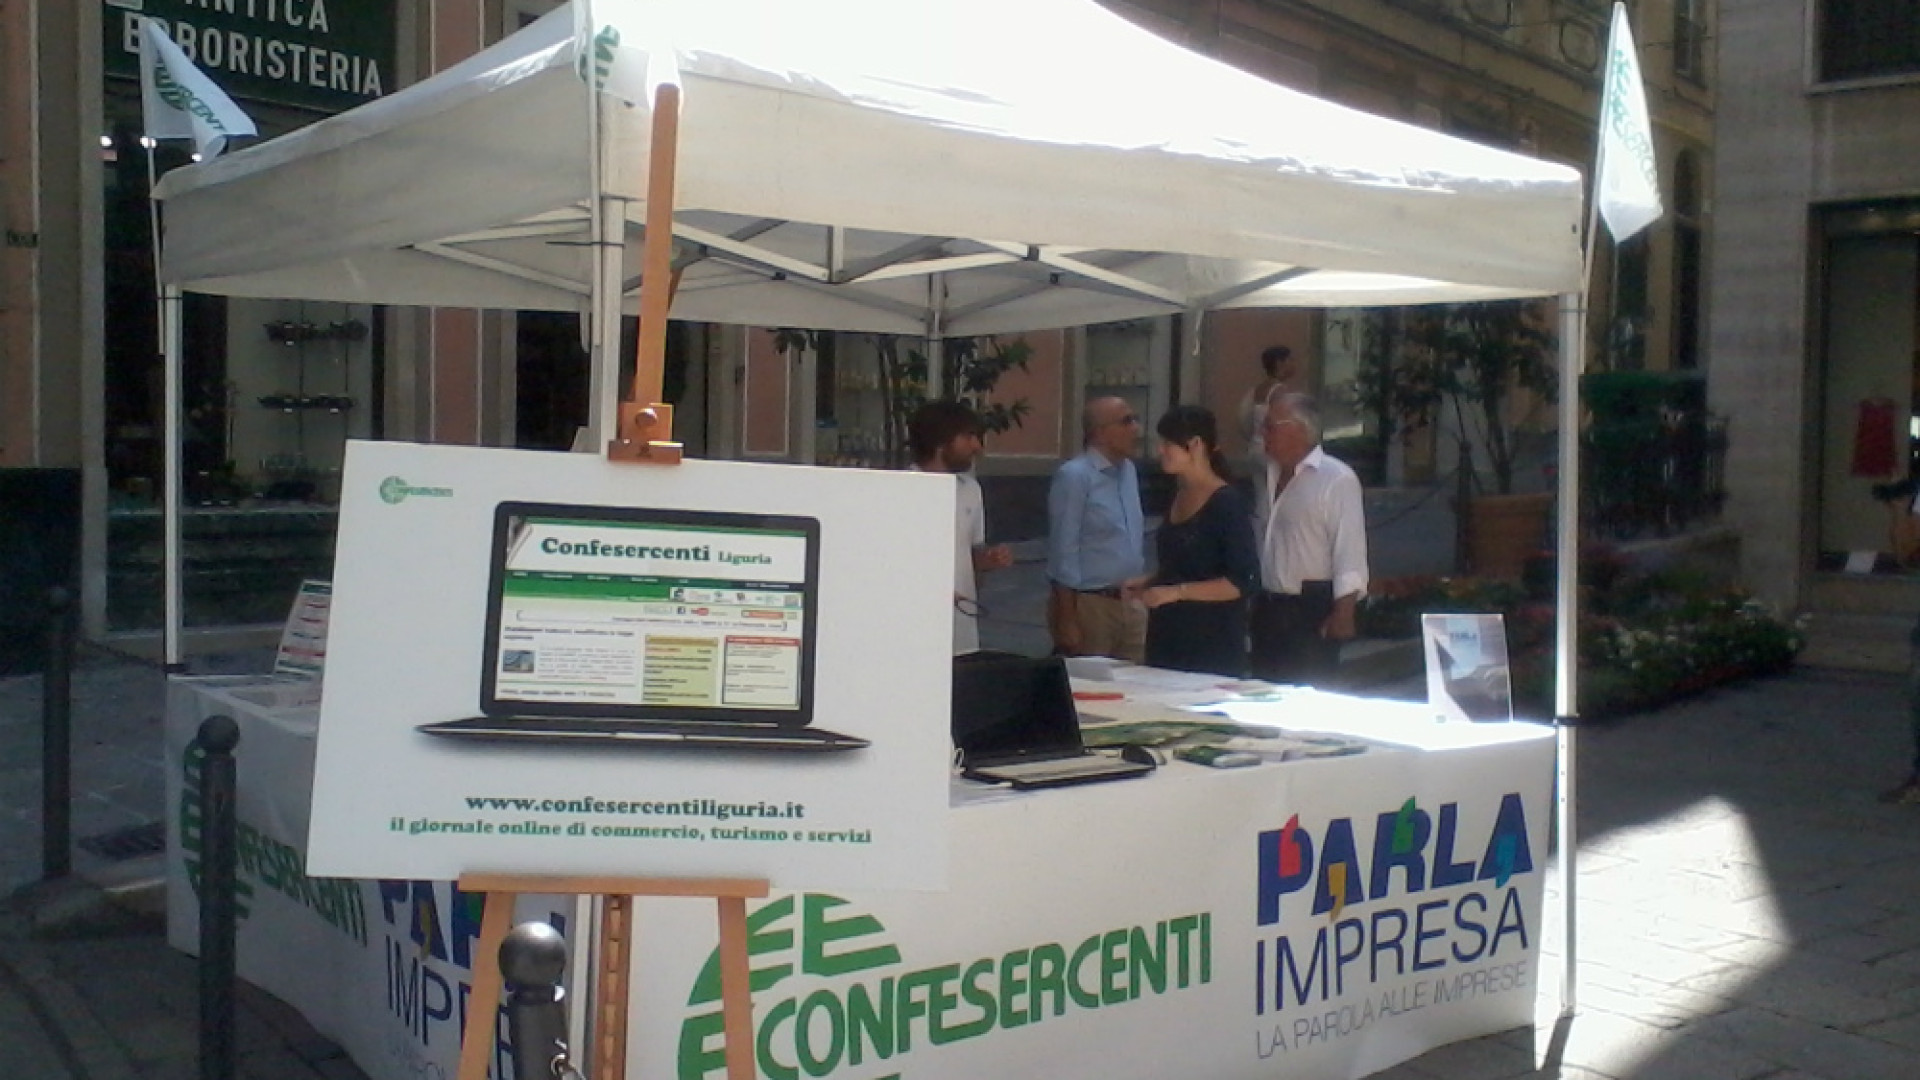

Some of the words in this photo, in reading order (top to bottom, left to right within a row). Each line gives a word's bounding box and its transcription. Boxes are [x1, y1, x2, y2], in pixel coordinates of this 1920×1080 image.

[124, 12, 383, 96] EBORISTERIA
[184, 0, 329, 33] ICA
[541, 537, 710, 561] Confesercenti
[718, 551, 772, 566] Liguria
[390, 817, 404, 831] il
[409, 818, 494, 835] giornale
[499, 820, 561, 836] online
[567, 822, 586, 836] di
[591, 824, 705, 841] commercio,
[711, 826, 788, 841] turismo
[793, 832, 802, 841] e
[808, 829, 872, 843] servizi
[465, 796, 805, 821] www.confesercentiliguria.it
[1257, 793, 1533, 926] PARLA
[1257, 887, 1528, 1016] IMPRESA
[756, 911, 1211, 1080] CONFESERCENTI
[1257, 1025, 1288, 1059] LA
[1294, 999, 1376, 1048] PAROLA
[1378, 980, 1428, 1018] ALLE
[1434, 960, 1527, 1004] IMPRESE
